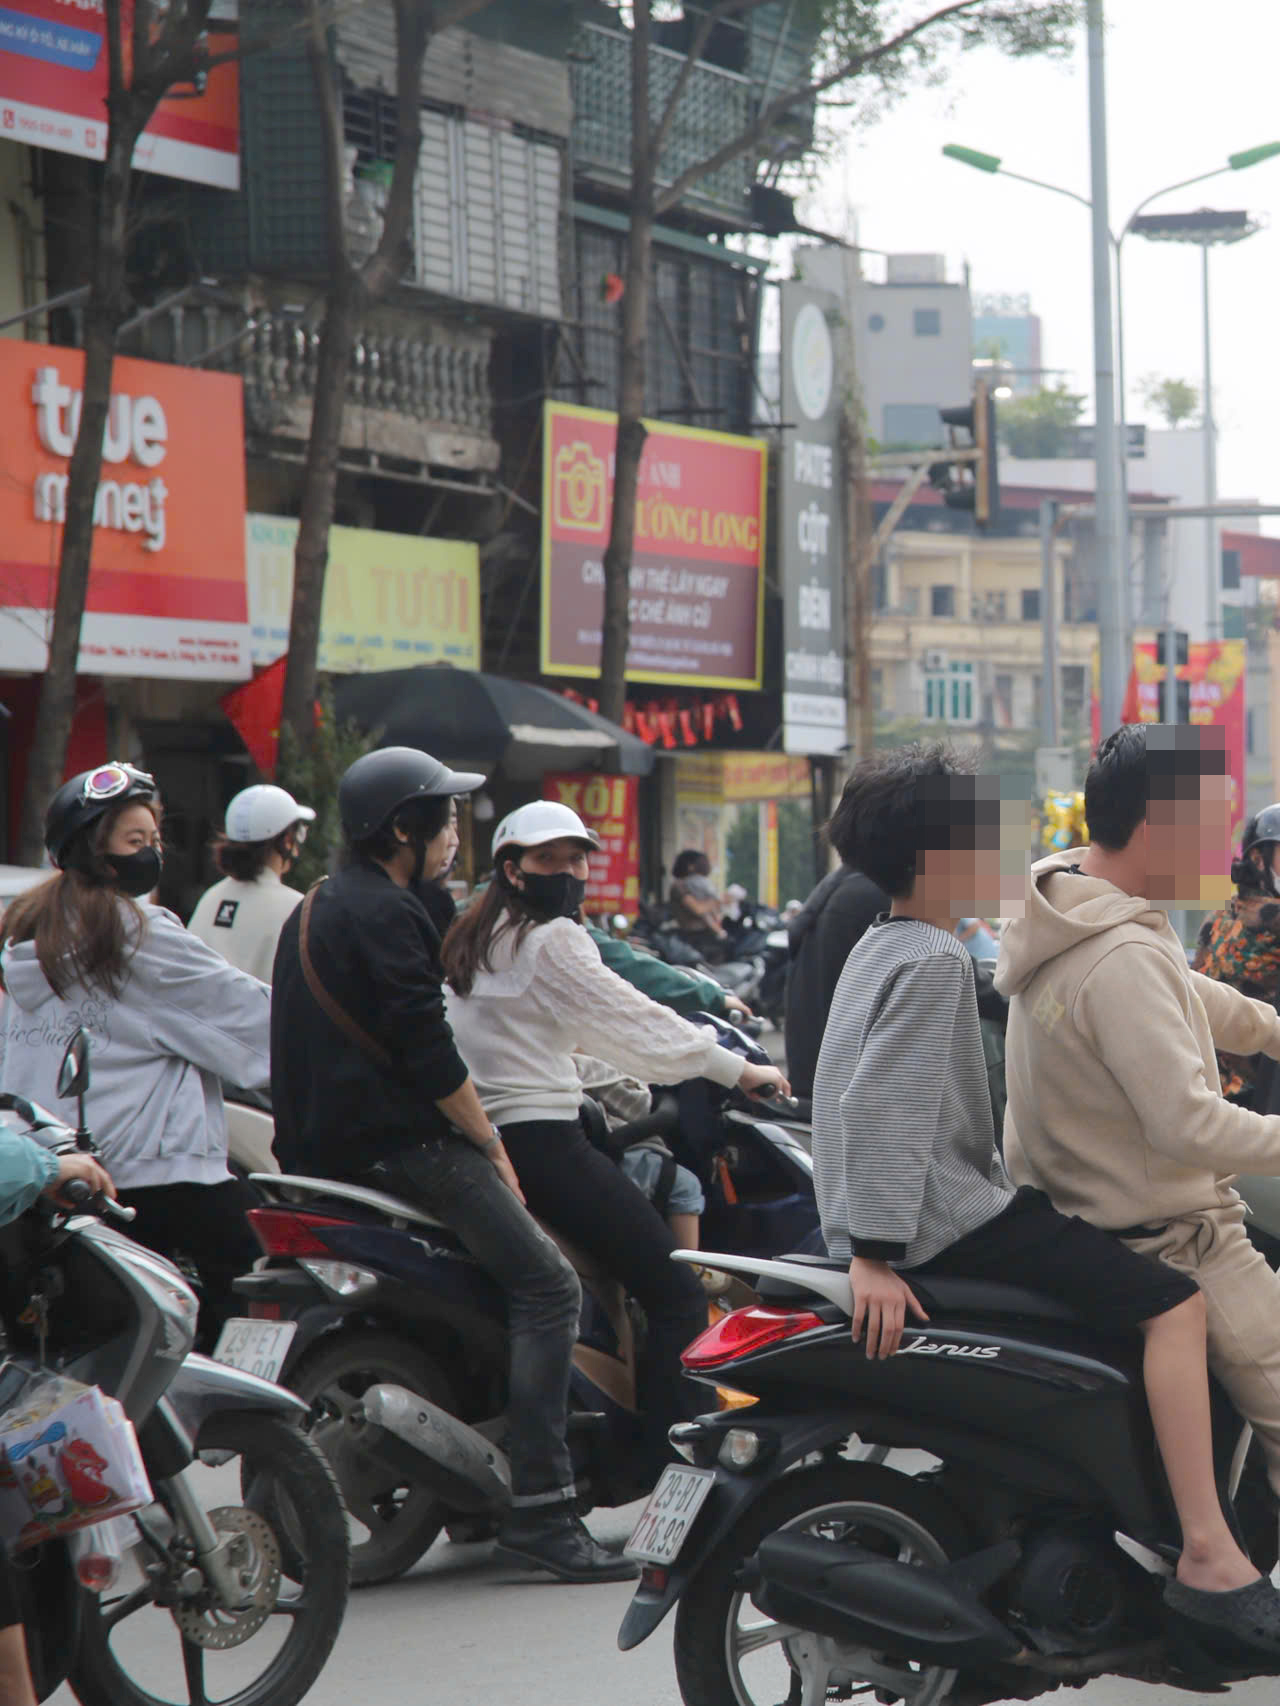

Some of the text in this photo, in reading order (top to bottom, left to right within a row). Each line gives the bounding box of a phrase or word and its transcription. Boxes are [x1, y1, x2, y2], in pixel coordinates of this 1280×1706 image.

[32, 365, 168, 468] tue
[34, 471, 168, 552] mney
[257, 552, 353, 622] HA
[896, 1335, 1002, 1359] Janus
